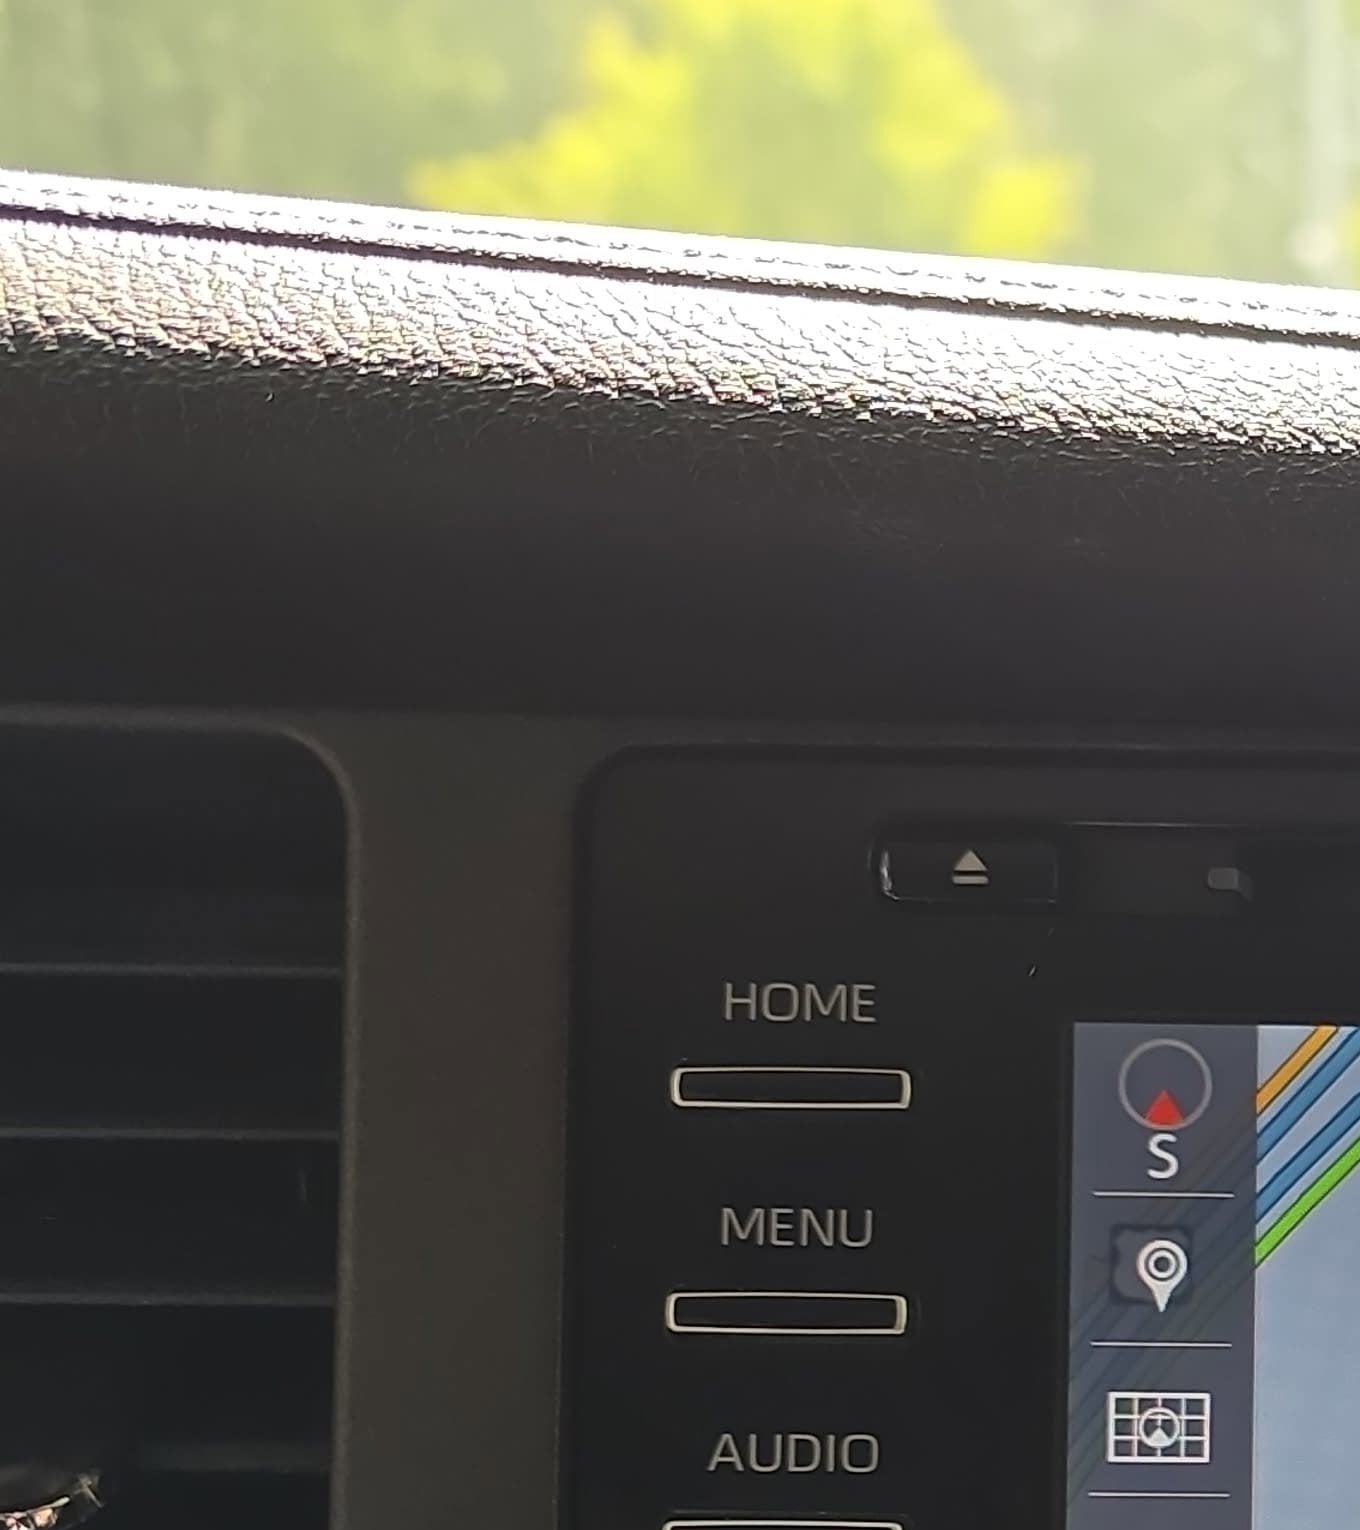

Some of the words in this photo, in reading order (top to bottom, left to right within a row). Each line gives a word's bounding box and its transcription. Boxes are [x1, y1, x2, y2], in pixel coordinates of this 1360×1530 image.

[722, 982, 878, 1023] HOME
[1146, 1133, 1180, 1180] S
[720, 1206, 875, 1248] MENU
[707, 1432, 881, 1474] AUDIO
